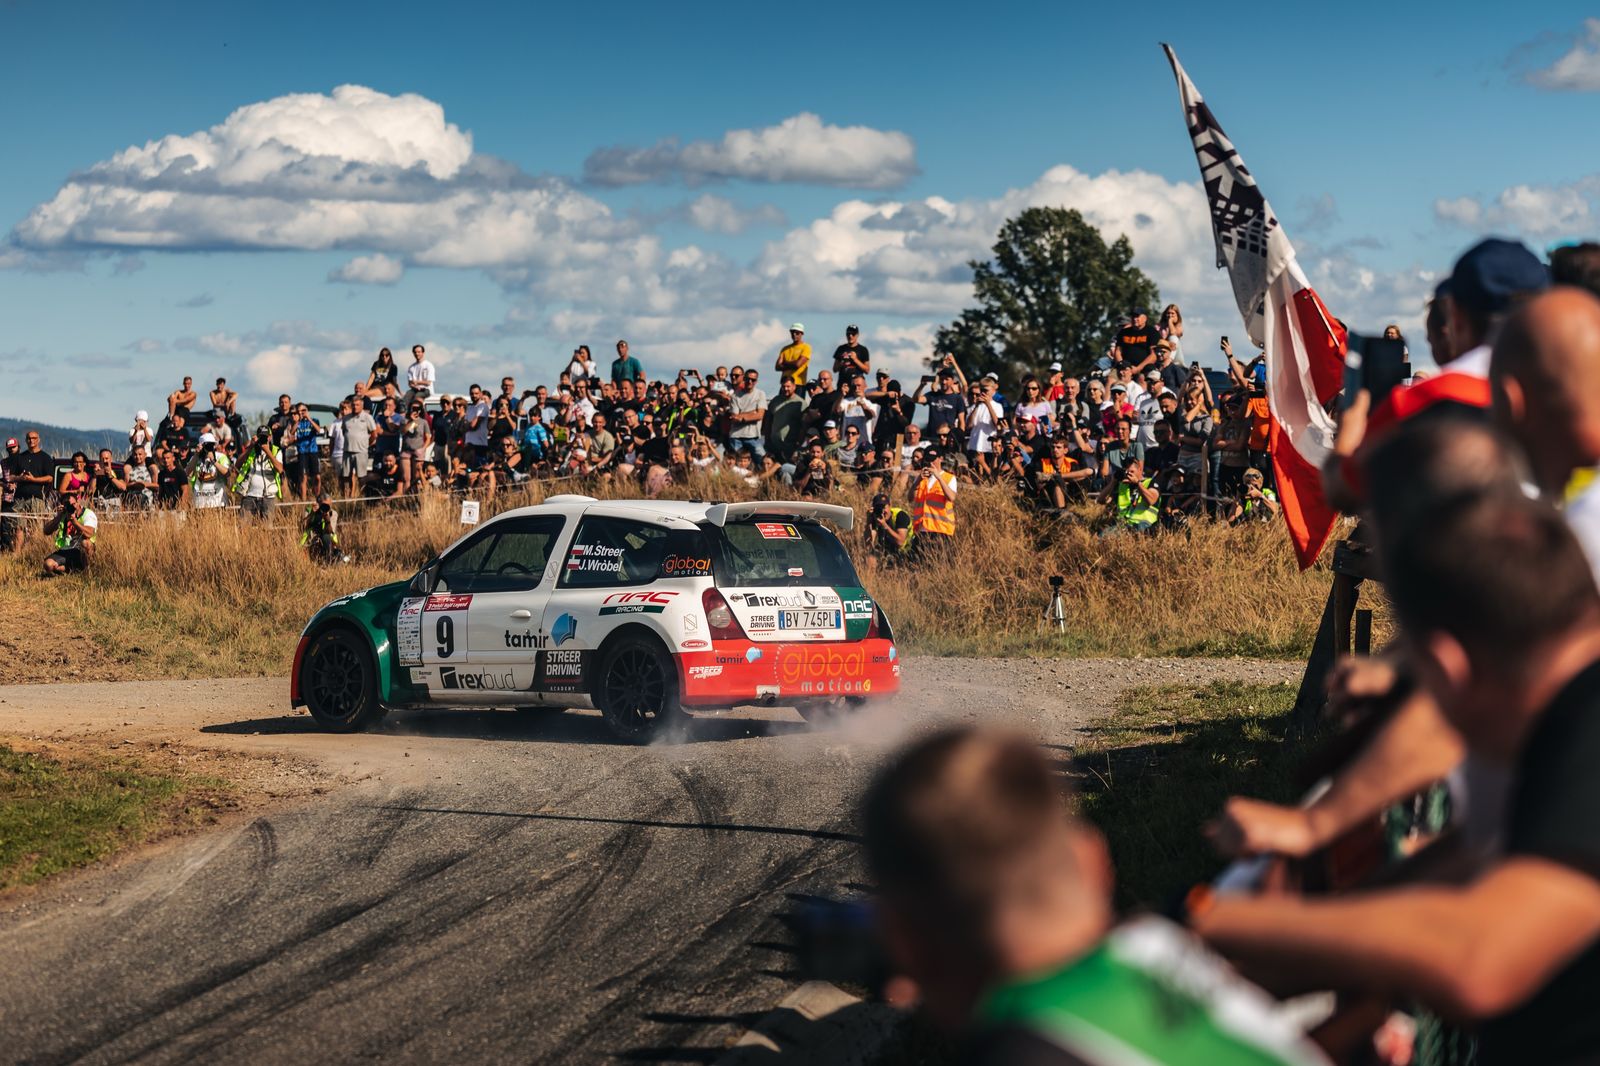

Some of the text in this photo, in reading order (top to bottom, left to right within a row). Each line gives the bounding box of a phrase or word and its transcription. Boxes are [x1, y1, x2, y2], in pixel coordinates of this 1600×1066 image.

[582, 544, 625, 557] M.Streer
[665, 556, 711, 573] global
[615, 605, 645, 613] RACING
[843, 600, 873, 612] NAC
[786, 611, 835, 628] BV 745PL
[436, 615, 455, 659] 9
[504, 629, 549, 649] tamir
[546, 650, 581, 663] STREER
[715, 653, 745, 664] tamir
[546, 664, 582, 676] DRIVING
[783, 646, 865, 684] global
[458, 666, 516, 690] rexbud
